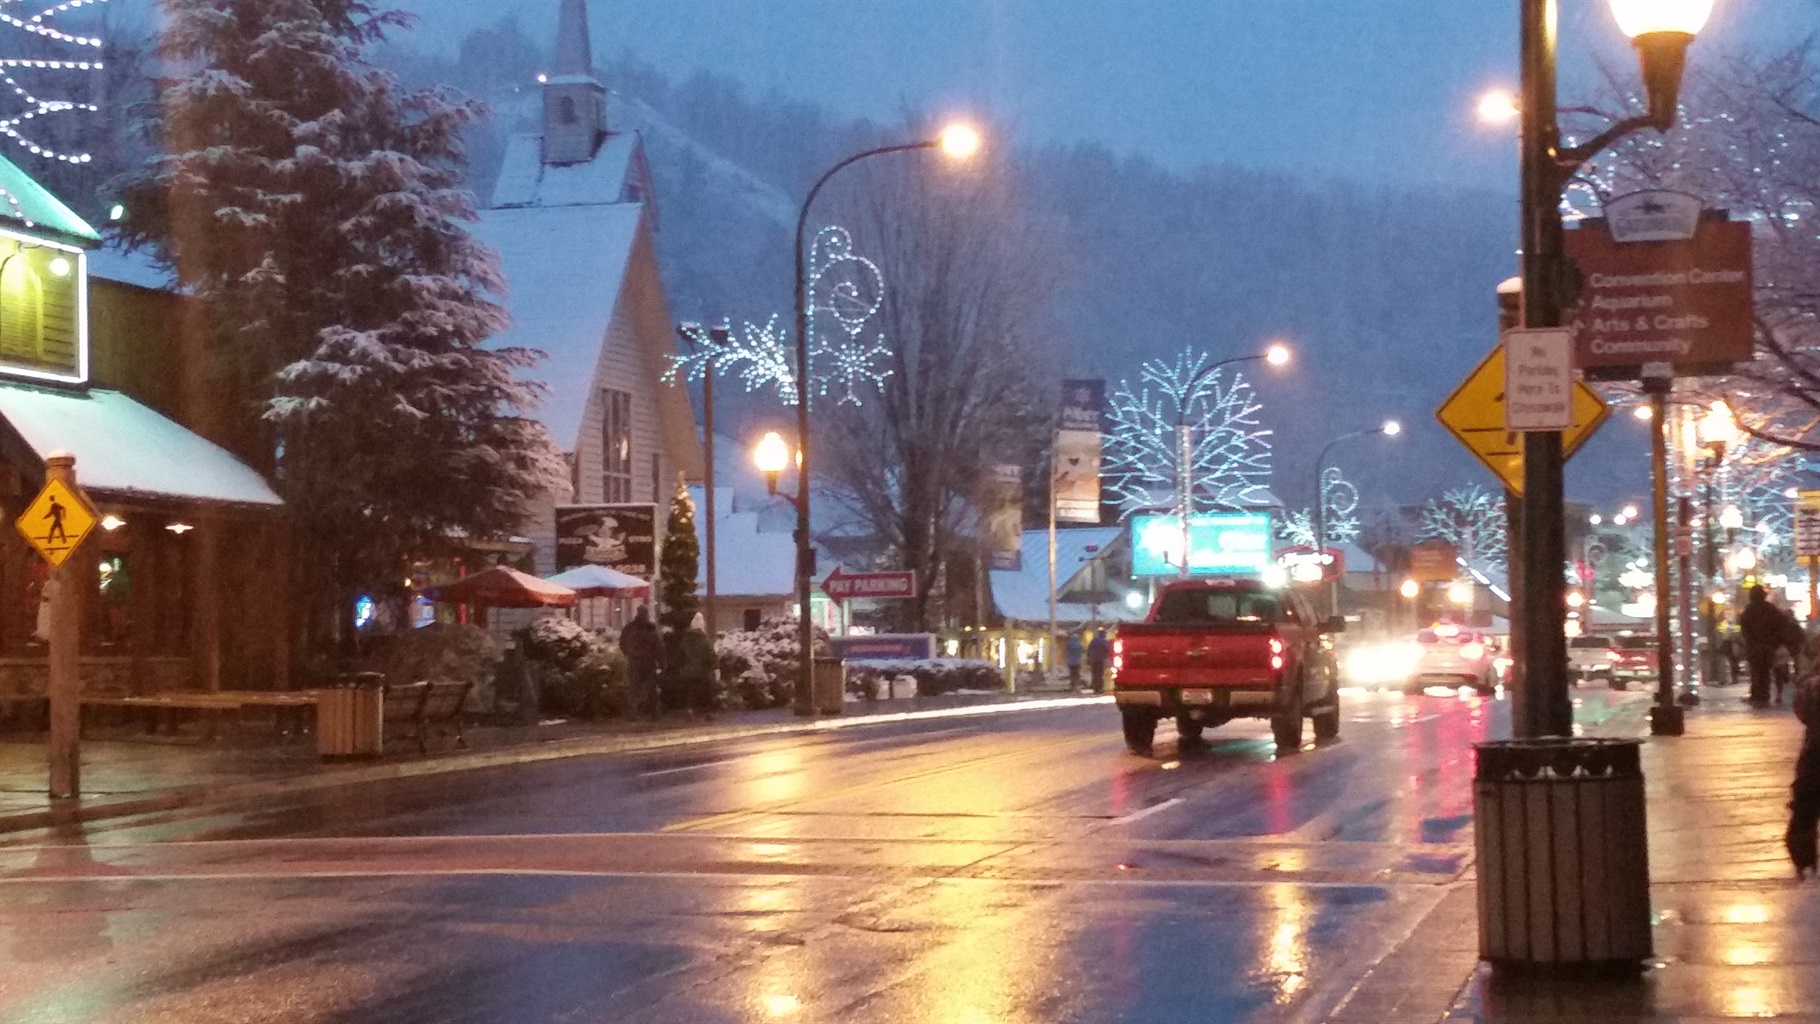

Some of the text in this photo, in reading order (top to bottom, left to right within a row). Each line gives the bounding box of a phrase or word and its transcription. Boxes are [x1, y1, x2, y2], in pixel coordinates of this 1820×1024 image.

[1590, 268, 1744, 288] Convention Center
[1592, 295, 1673, 311] Aquarium
[1593, 314, 1710, 332] Arts & Crafts
[1591, 338, 1692, 355] Community
[830, 577, 908, 592] PAY PARKING
